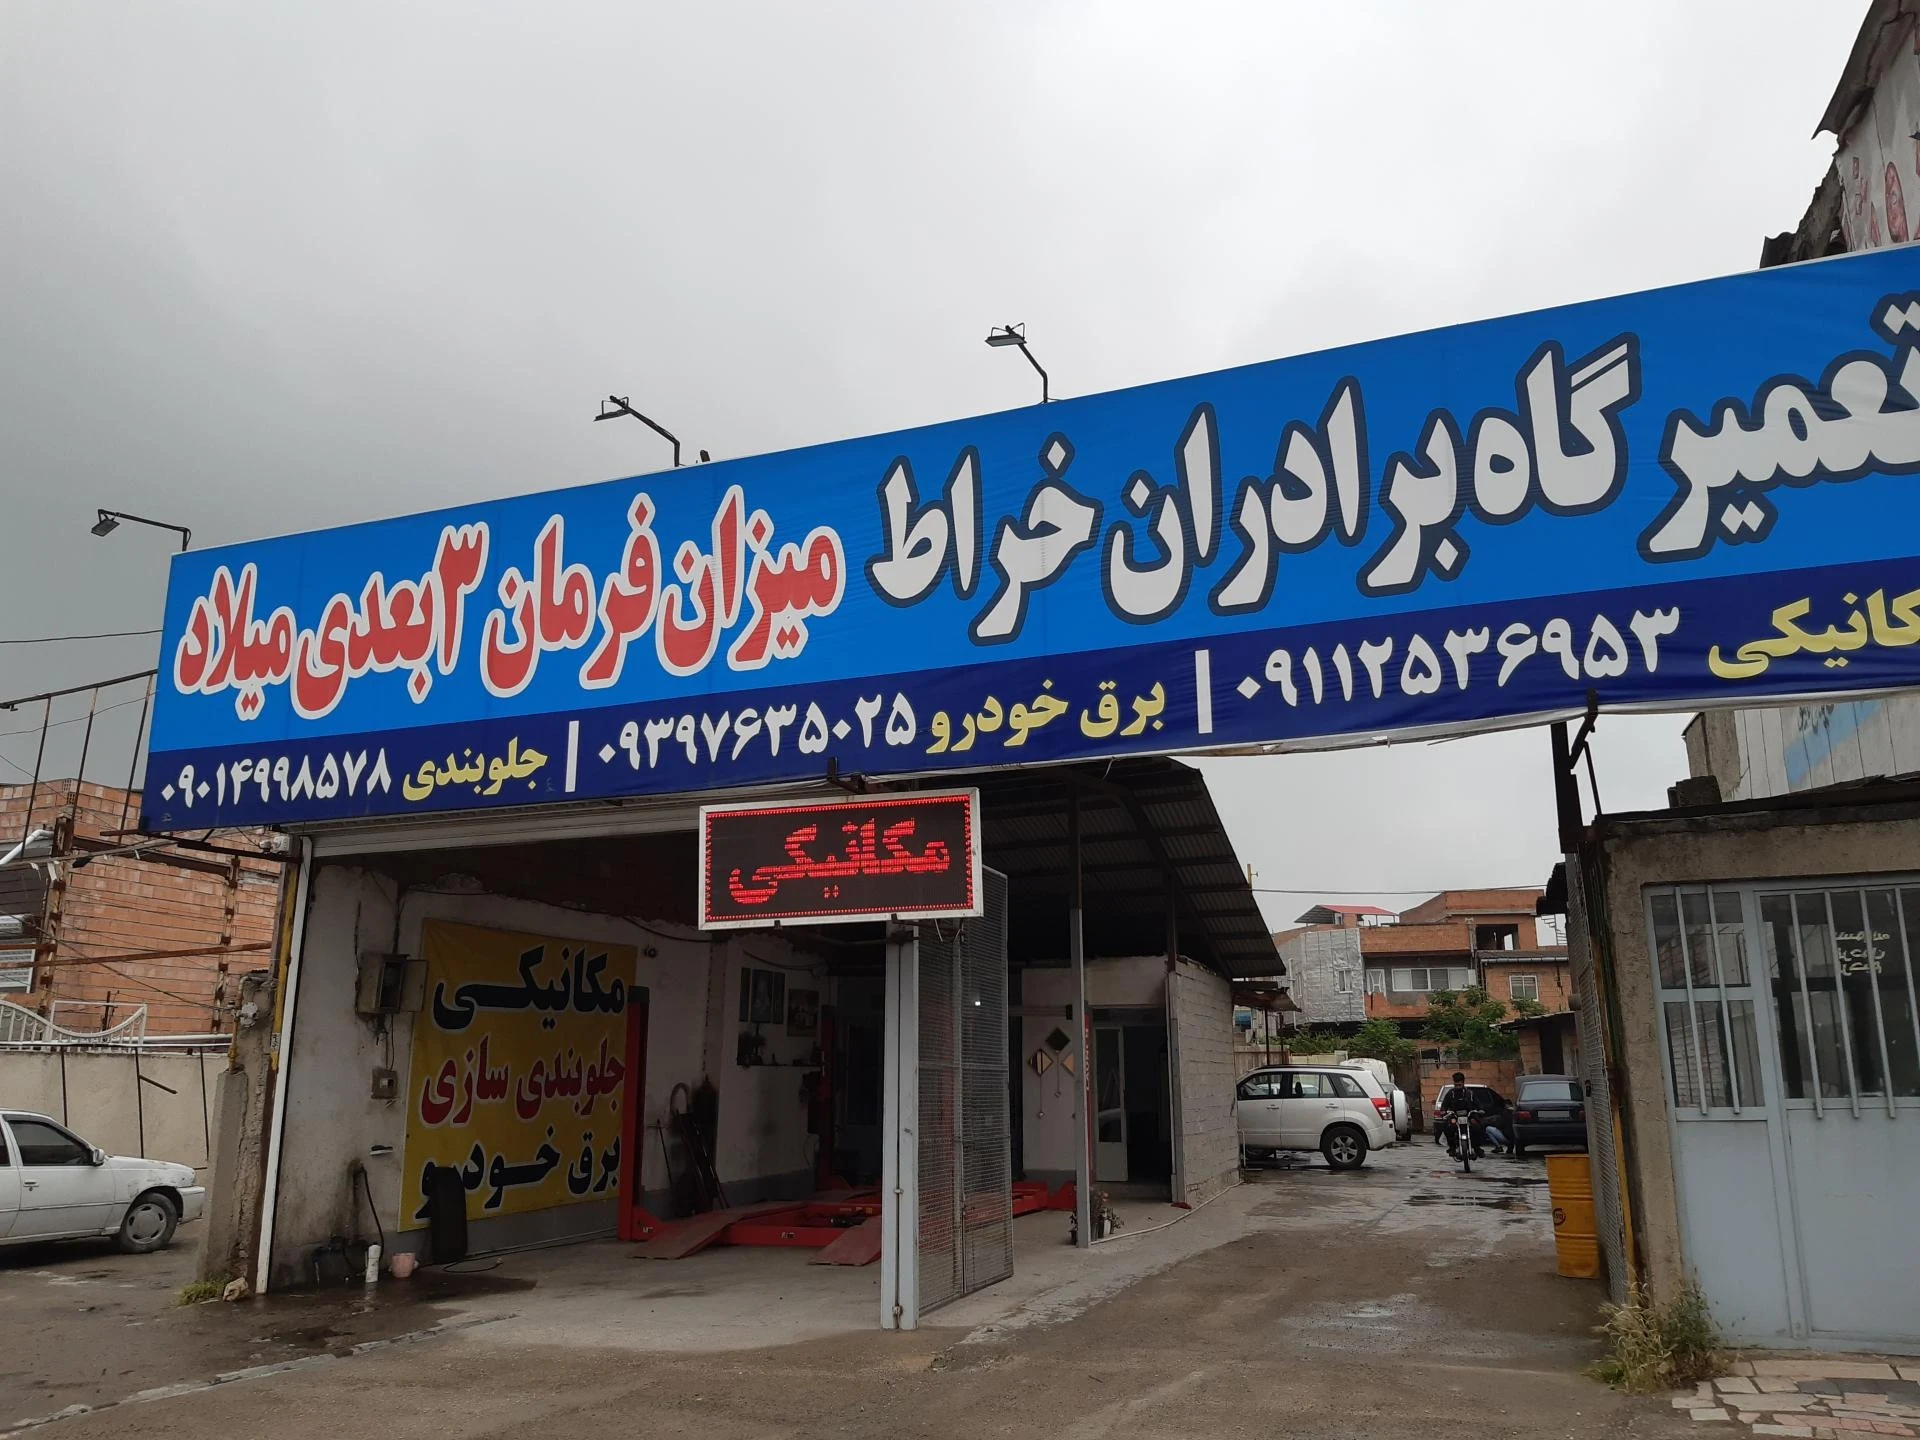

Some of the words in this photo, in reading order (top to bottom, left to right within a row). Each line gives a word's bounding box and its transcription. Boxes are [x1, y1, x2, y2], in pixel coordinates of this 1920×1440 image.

[868, 433, 1102, 645] خراط
[1101, 378, 1466, 621] برادران
[481, 493, 661, 698] فرمان
[656, 485, 846, 675] میزان
[175, 563, 295, 721] میلاد
[1237, 606, 1680, 708] ۰۹۱۱۲۵۳۶۹۵۳
[1708, 587, 1920, 679] کانیکی
[599, 692, 917, 770] ۰۹۳۹۷۶۳۵۰۲۵
[926, 680, 1069, 753] خودرو
[1080, 679, 1166, 738] برق
[161, 748, 392, 809] ۰۹۰۱۴۹۹۸۵۷۸
[403, 736, 548, 801] جلوبندی
[729, 817, 951, 904] مکانیکی
[433, 945, 625, 1030] مکانیکی
[421, 1035, 509, 1125] سازی
[516, 1037, 626, 1121] جلوبندی
[414, 1125, 561, 1220] خودو
[568, 1131, 620, 1195] برق
